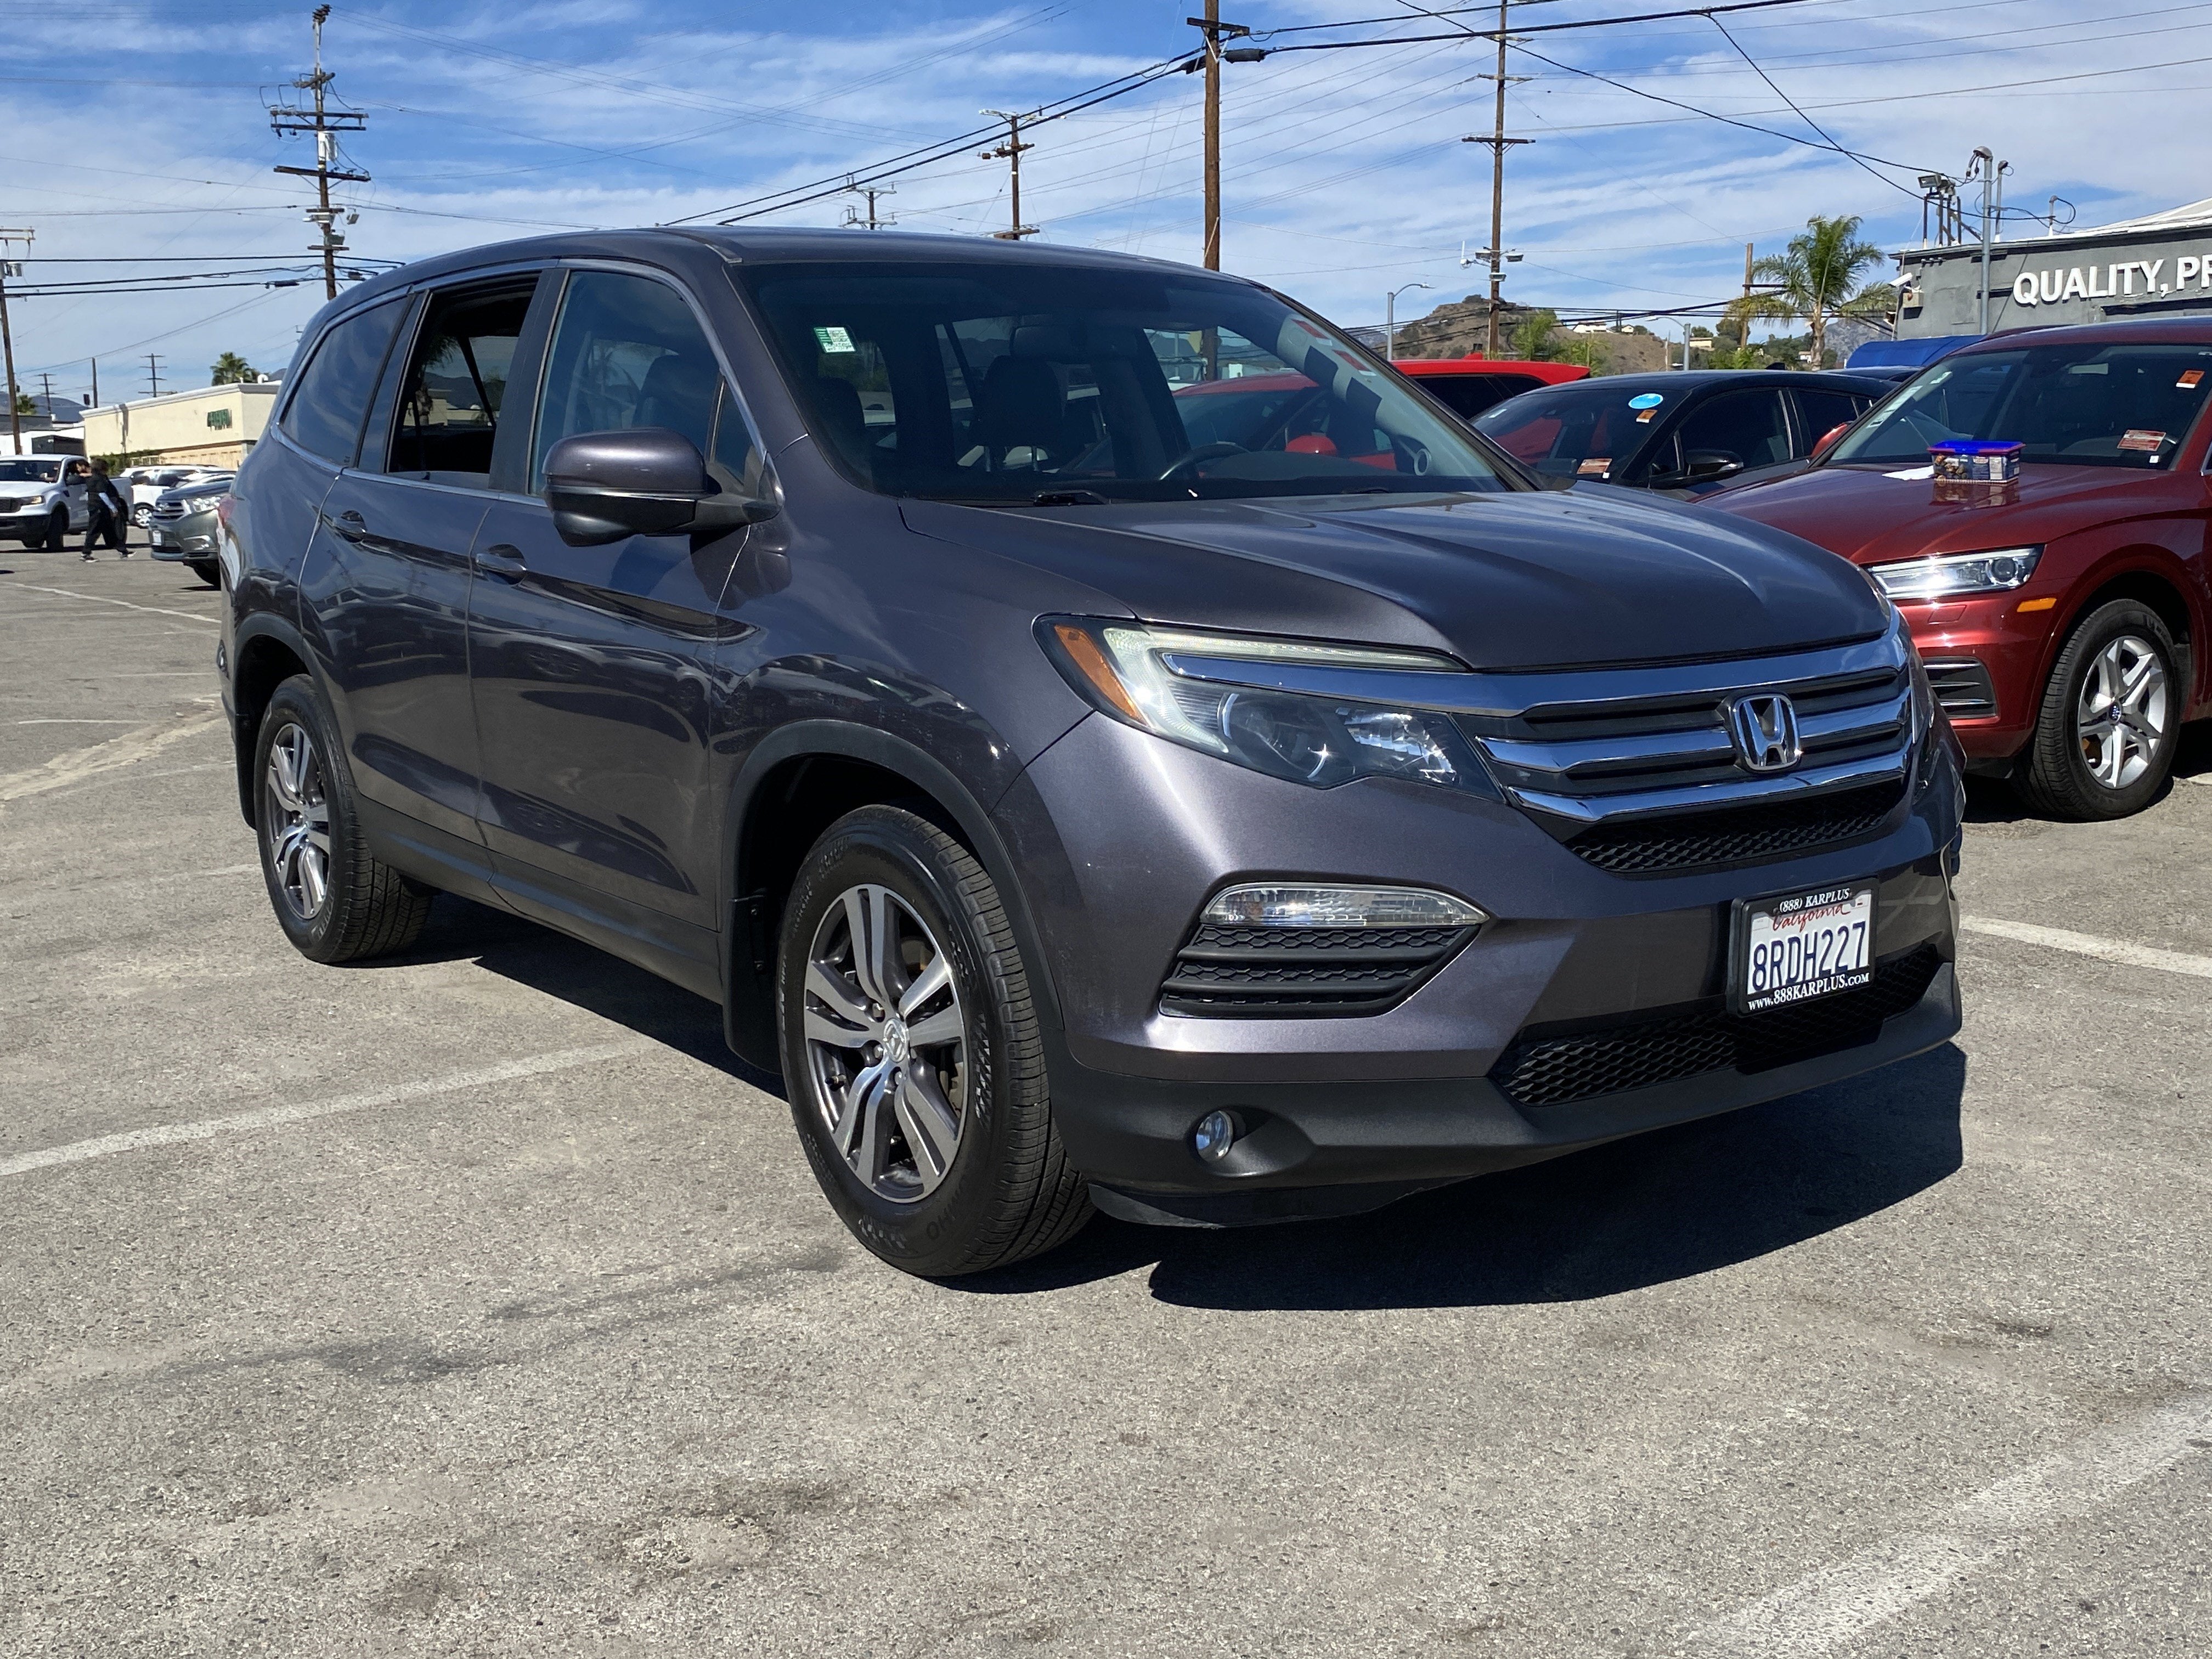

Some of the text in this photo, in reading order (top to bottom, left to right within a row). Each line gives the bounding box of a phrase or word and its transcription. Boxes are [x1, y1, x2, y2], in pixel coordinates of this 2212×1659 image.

[2013, 259, 2168, 305] QUALITY,
[1773, 904, 1851, 933] California
[1779, 888, 1850, 913] (888) KARPLUS
[1752, 921, 1866, 991] 8RDH227
